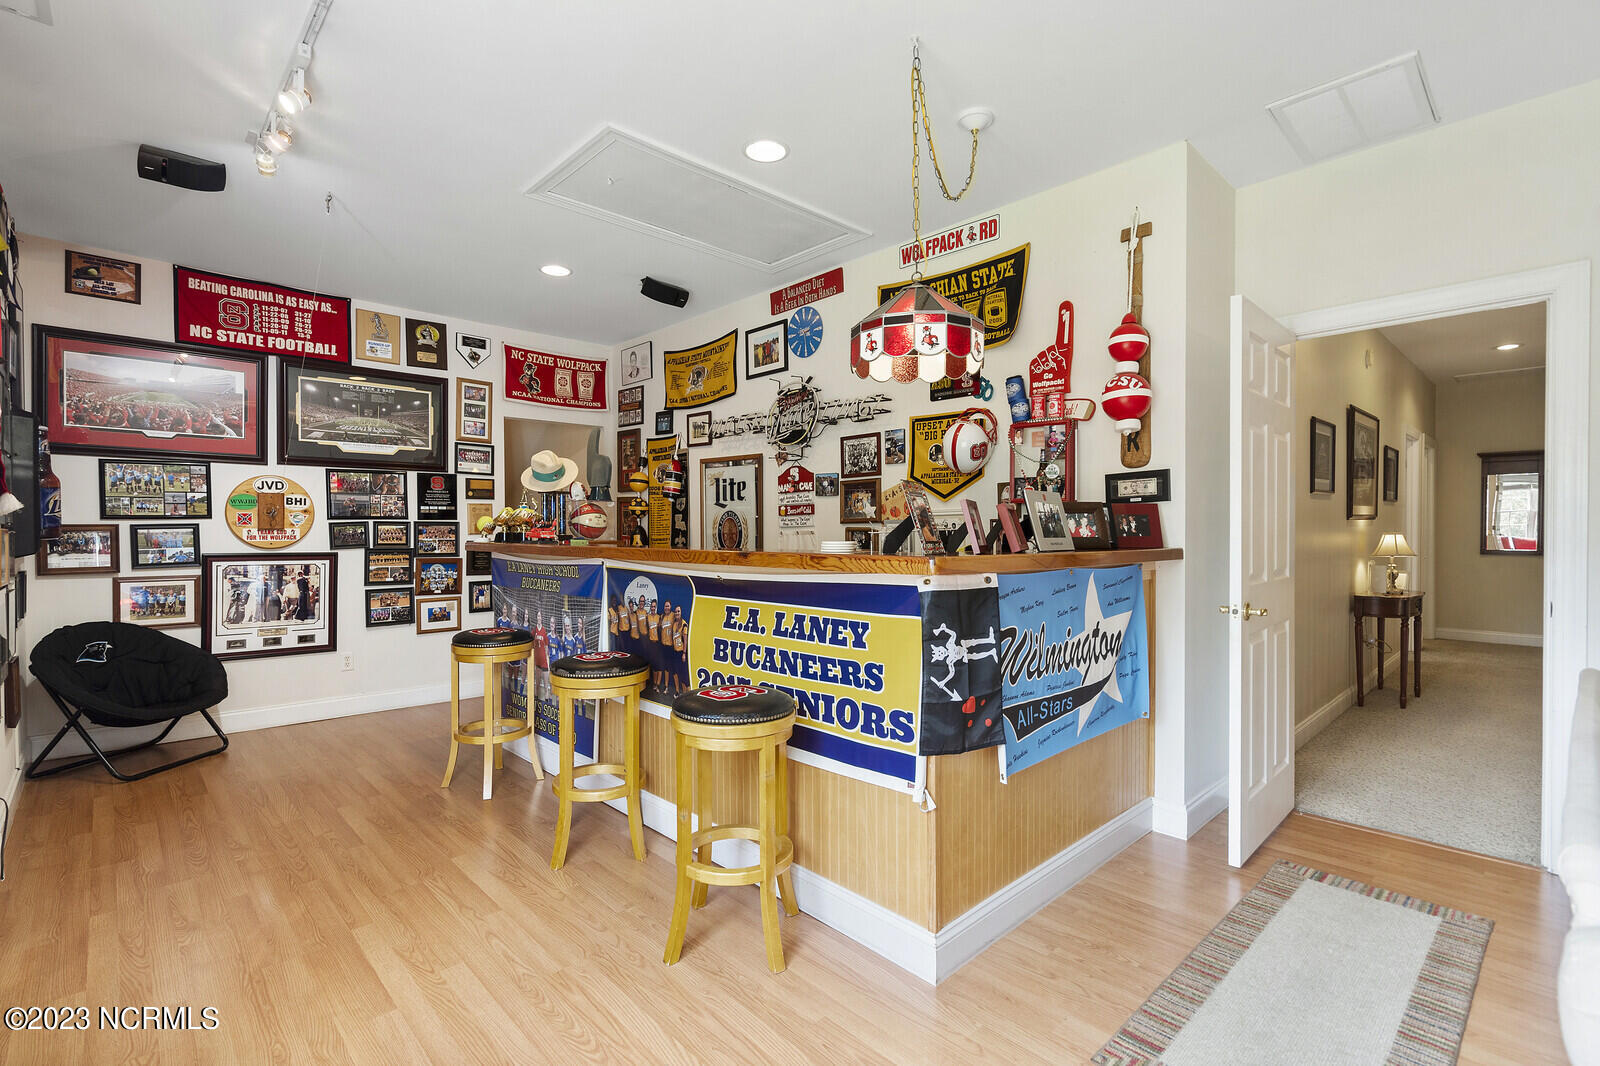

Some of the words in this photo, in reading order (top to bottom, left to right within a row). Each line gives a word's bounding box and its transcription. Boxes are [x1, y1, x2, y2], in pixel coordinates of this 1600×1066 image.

[901, 229, 964, 265] WOLFPACK
[979, 218, 998, 241] RD
[971, 259, 1016, 289] STATE
[188, 277, 228, 295] BEATING
[229, 285, 274, 303] CAROLINA
[275, 293, 284, 304] IS
[285, 296, 297, 308] AS
[299, 298, 320, 312] EASY
[782, 289, 787, 300] A
[189, 324, 212, 339] NC
[216, 329, 265, 347] STATE
[267, 336, 338, 356] FOOTBALL
[984, 328, 1011, 340] OOTBALL
[511, 349, 525, 361] NC
[526, 352, 555, 367] STATE
[557, 358, 603, 372] WOLFPACK
[1043, 372, 1054, 380] Go
[512, 390, 533, 399] NCAA
[566, 399, 601, 408] CHAMPIONS
[916, 421, 943, 431] UPSET
[257, 480, 285, 490] JVD
[714, 477, 746, 509] Lite
[799, 481, 813, 491] CAVE
[286, 497, 306, 506] BHI
[554, 565, 579, 578] SCHOOL
[521, 576, 561, 592] BUCCANEERS
[723, 606, 766, 635] E.A.
[772, 611, 871, 650] LANEY
[1000, 621, 1122, 686] Wilmington
[713, 638, 884, 693] BUCANEERS
[758, 681, 915, 744] NIORS
[1017, 697, 1073, 730] All-Stars
[548, 722, 556, 736] OF
